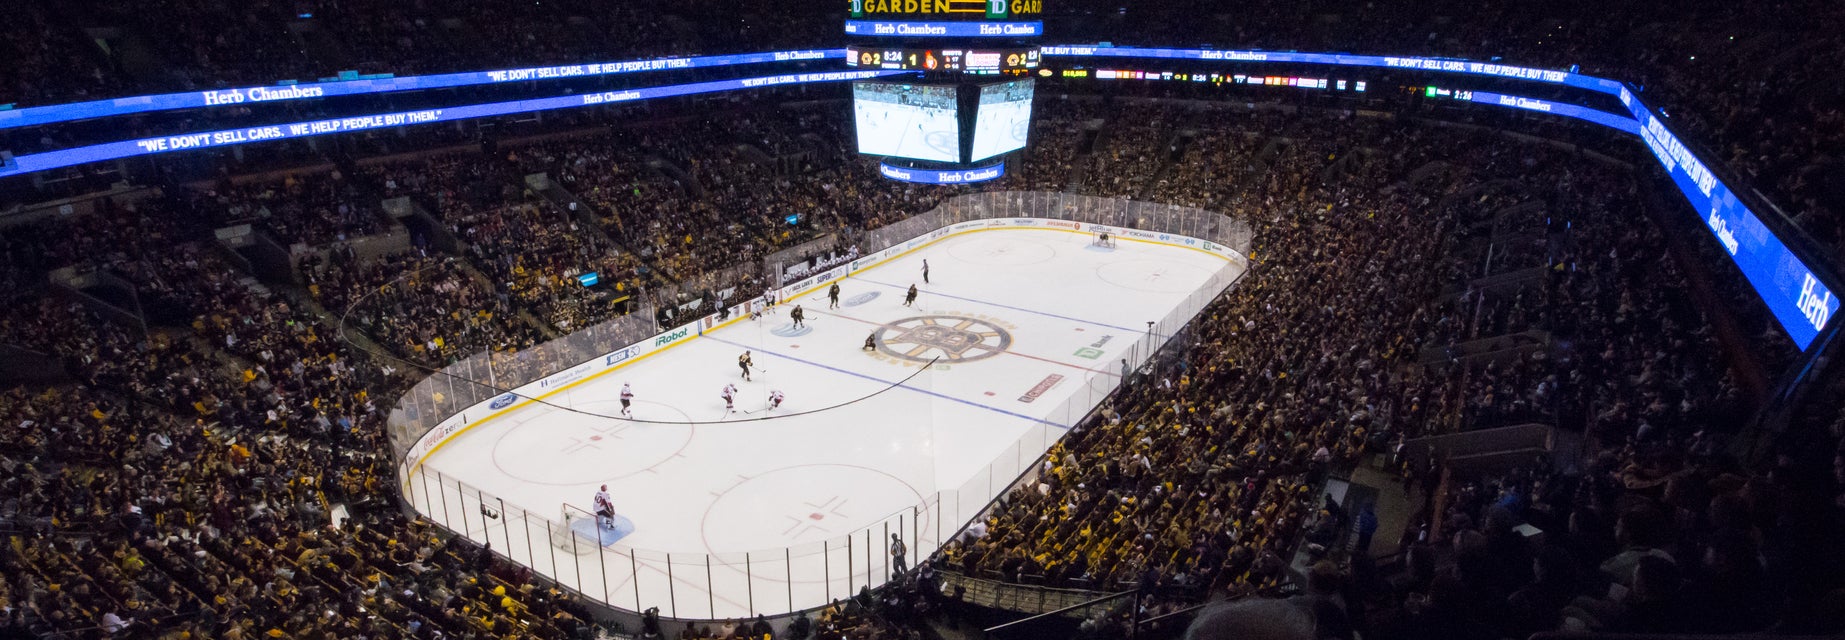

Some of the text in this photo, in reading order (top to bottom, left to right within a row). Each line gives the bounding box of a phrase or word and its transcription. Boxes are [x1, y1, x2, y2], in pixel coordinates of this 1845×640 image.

[864, 0, 950, 13] GARDEN
[875, 23, 946, 34] Herb Chambers
[980, 24, 1002, 35] Herb
[775, 50, 824, 61] Herb Chambers
[883, 51, 902, 61] 8:24
[1055, 47, 1071, 55] BUY
[1202, 50, 1267, 61] Herb Chambers
[873, 53, 881, 65] 2
[909, 54, 917, 66] 1
[1020, 53, 1026, 65] 2
[538, 67, 560, 78] SELL
[561, 66, 585, 77] CARS.
[588, 64, 602, 74] WE
[602, 62, 623, 74] HELP
[623, 61, 651, 72] PEOPLE
[652, 59, 667, 69] BUY
[1423, 60, 1442, 70] SELL
[1443, 61, 1466, 72] CARS.
[1470, 63, 1483, 73] WE
[1483, 64, 1500, 75] HELP
[1501, 66, 1527, 78] PEOPLE
[1527, 69, 1543, 79] BUY
[768, 76, 779, 85] SELL
[779, 75, 796, 84] CARS.
[799, 74, 809, 82] WE
[809, 73, 823, 82] HELP
[824, 72, 845, 81] PEOPLE
[204, 84, 323, 106] Herb Chambers
[583, 90, 640, 105] Herb Chambers
[1454, 89, 1472, 101] 2:26
[1500, 95, 1551, 112] Herb Chambers
[214, 129, 246, 144] SELL
[248, 126, 285, 141] CARS.
[289, 124, 310, 136] WE
[311, 121, 341, 134] HELP
[343, 116, 384, 130] PEOPLE
[385, 113, 406, 126] BUY
[939, 172, 962, 182] Herb
[1708, 207, 1738, 256] Herb Chambers
[1796, 272, 1830, 332] Herb
[655, 327, 688, 347] iRobot
[494, 396, 514, 409] Ford
